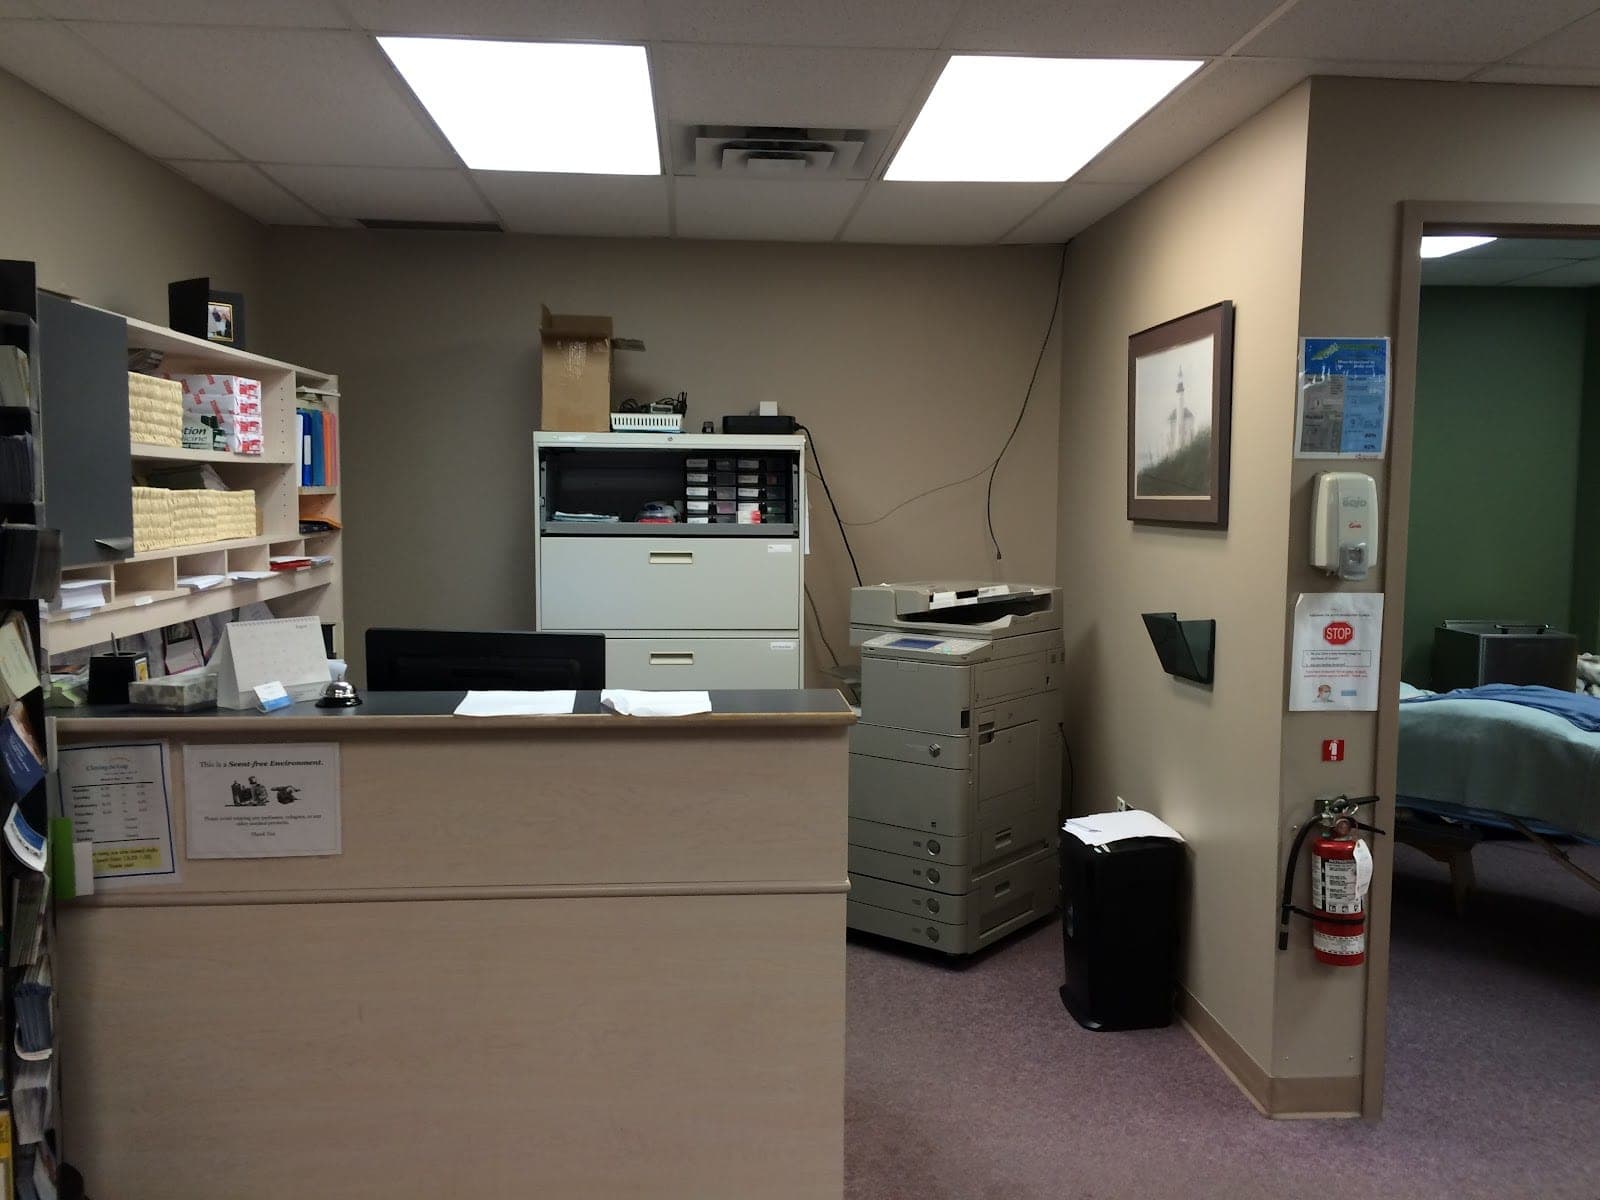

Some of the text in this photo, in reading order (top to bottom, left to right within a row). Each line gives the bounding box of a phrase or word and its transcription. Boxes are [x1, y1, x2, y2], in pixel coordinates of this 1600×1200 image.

[1326, 627, 1353, 640] STOP
[228, 760, 268, 768] Scent-free
[269, 759, 324, 767] Environment.
